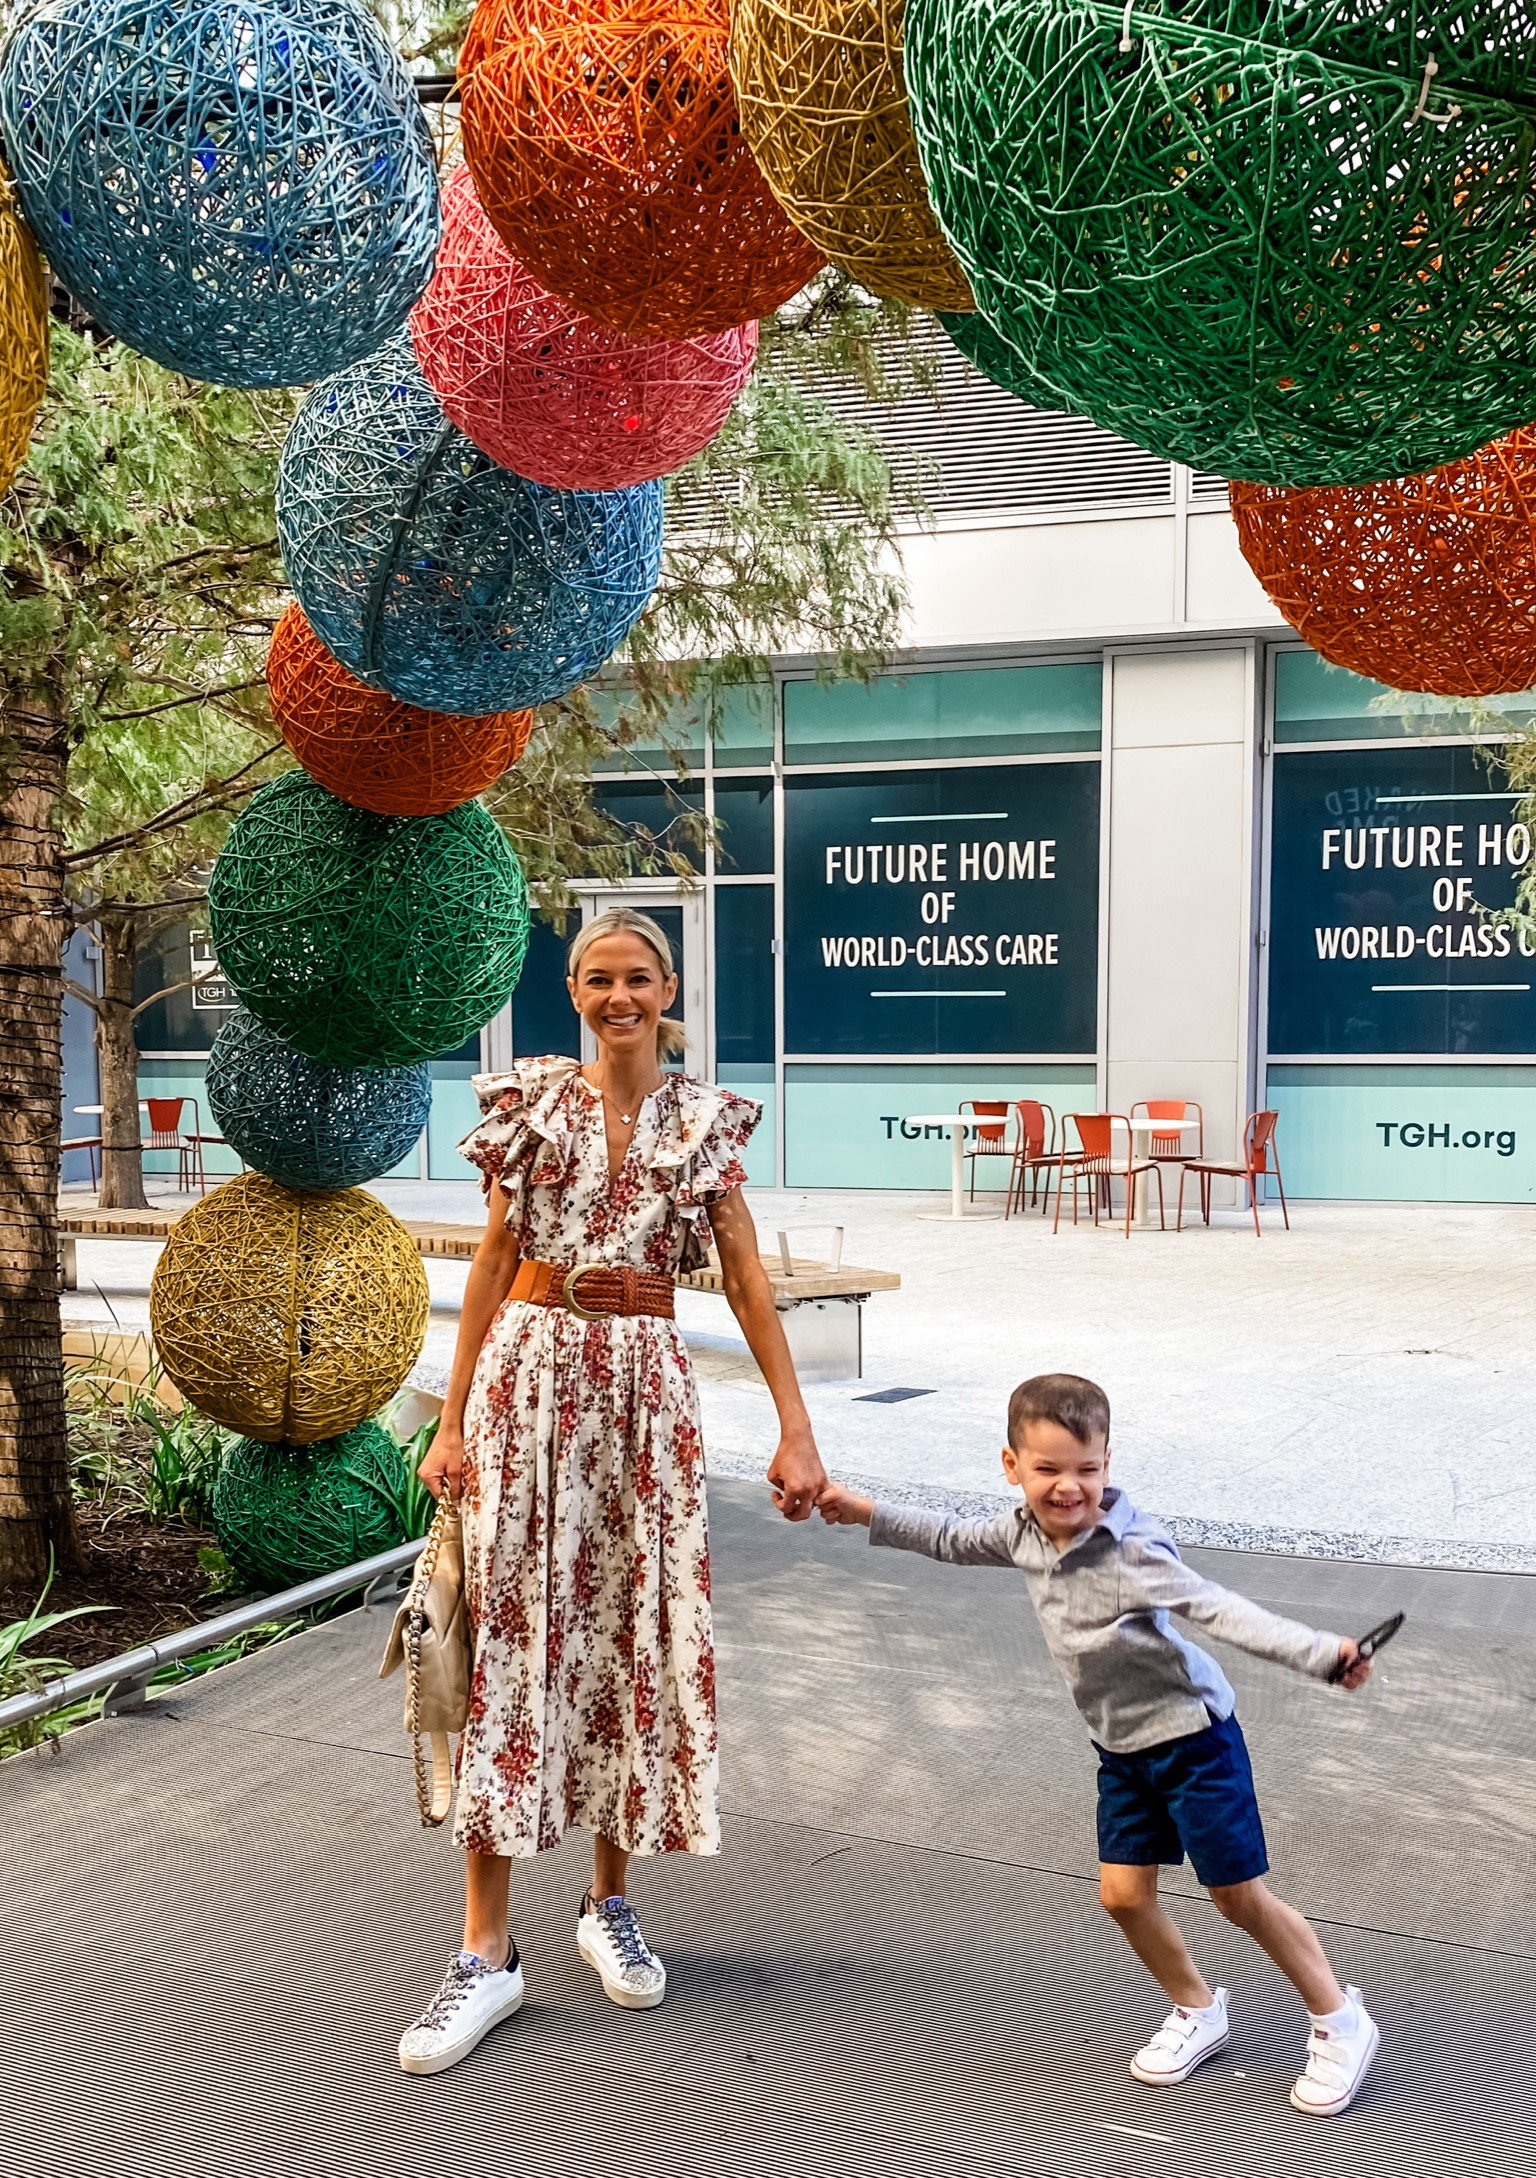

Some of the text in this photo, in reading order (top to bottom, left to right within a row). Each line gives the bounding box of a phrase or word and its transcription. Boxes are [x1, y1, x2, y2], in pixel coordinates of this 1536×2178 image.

[825, 839, 1056, 885] FUTURE HOME
[1321, 825, 1464, 870] FUTURE
[1478, 823, 1536, 866] HO
[920, 891, 956, 924] OF
[1432, 877, 1473, 913] OF
[821, 933, 1059, 968] WORLD-CLASS CARE
[1315, 924, 1511, 960] WORLD-CLASS
[201, 987, 226, 998] TGH
[1376, 1122, 1517, 1157] TGH.org
